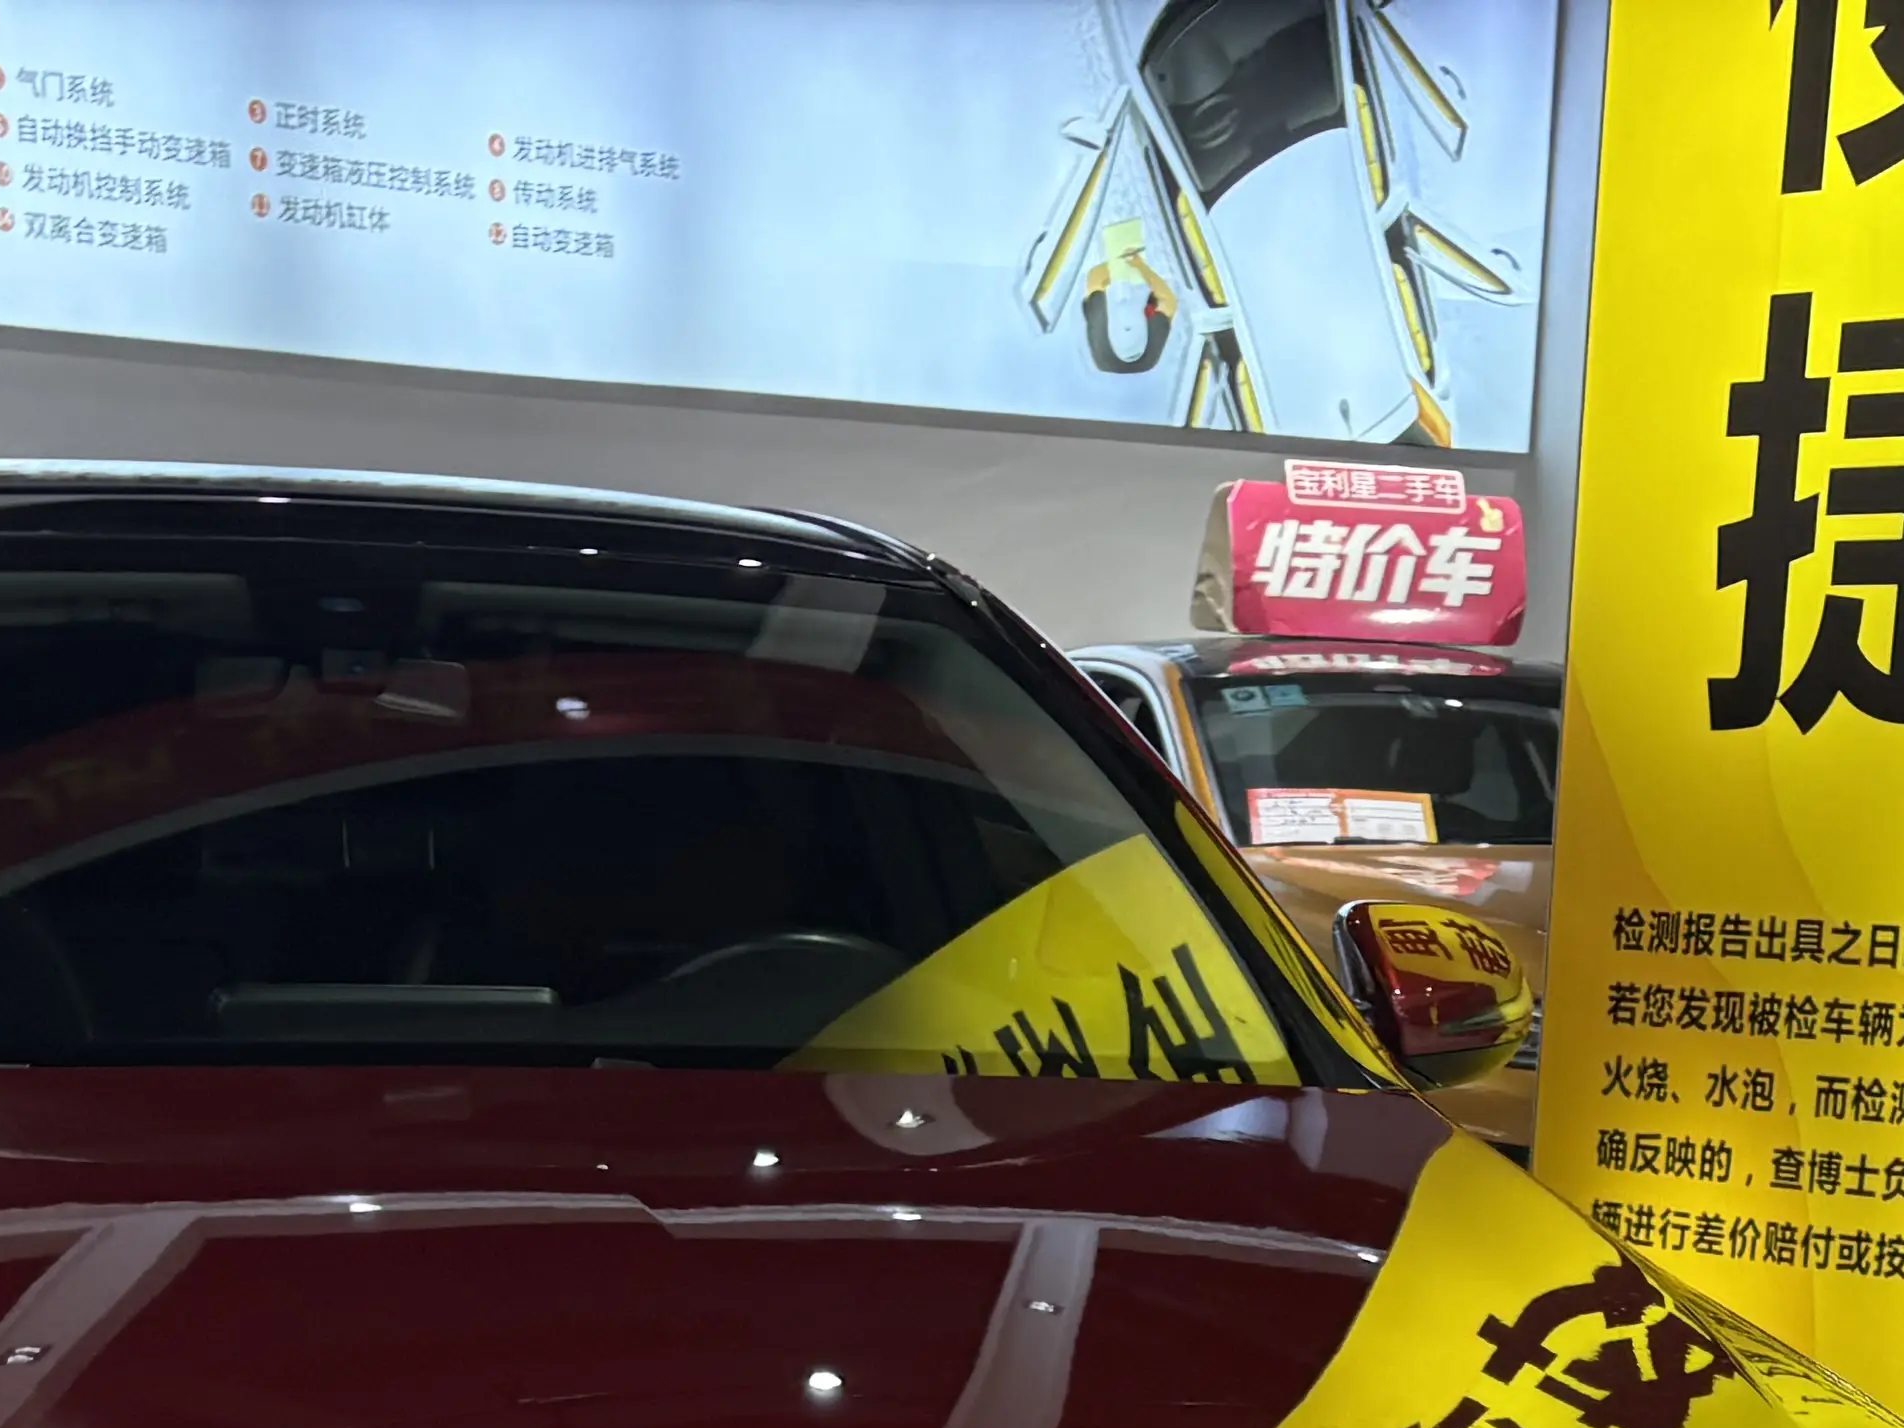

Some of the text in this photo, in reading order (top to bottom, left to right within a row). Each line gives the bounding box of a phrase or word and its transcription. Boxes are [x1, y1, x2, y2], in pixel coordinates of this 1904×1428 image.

[16, 67, 115, 108] 气门系统
[274, 100, 367, 140] 正时系统
[22, 164, 192, 211] 发动机控制系统
[512, 179, 598, 214] 传动系统
[511, 223, 615, 259] 自动变速箱
[1294, 467, 1463, 506] 宝利星二手车
[1250, 519, 1504, 608] 特价车
